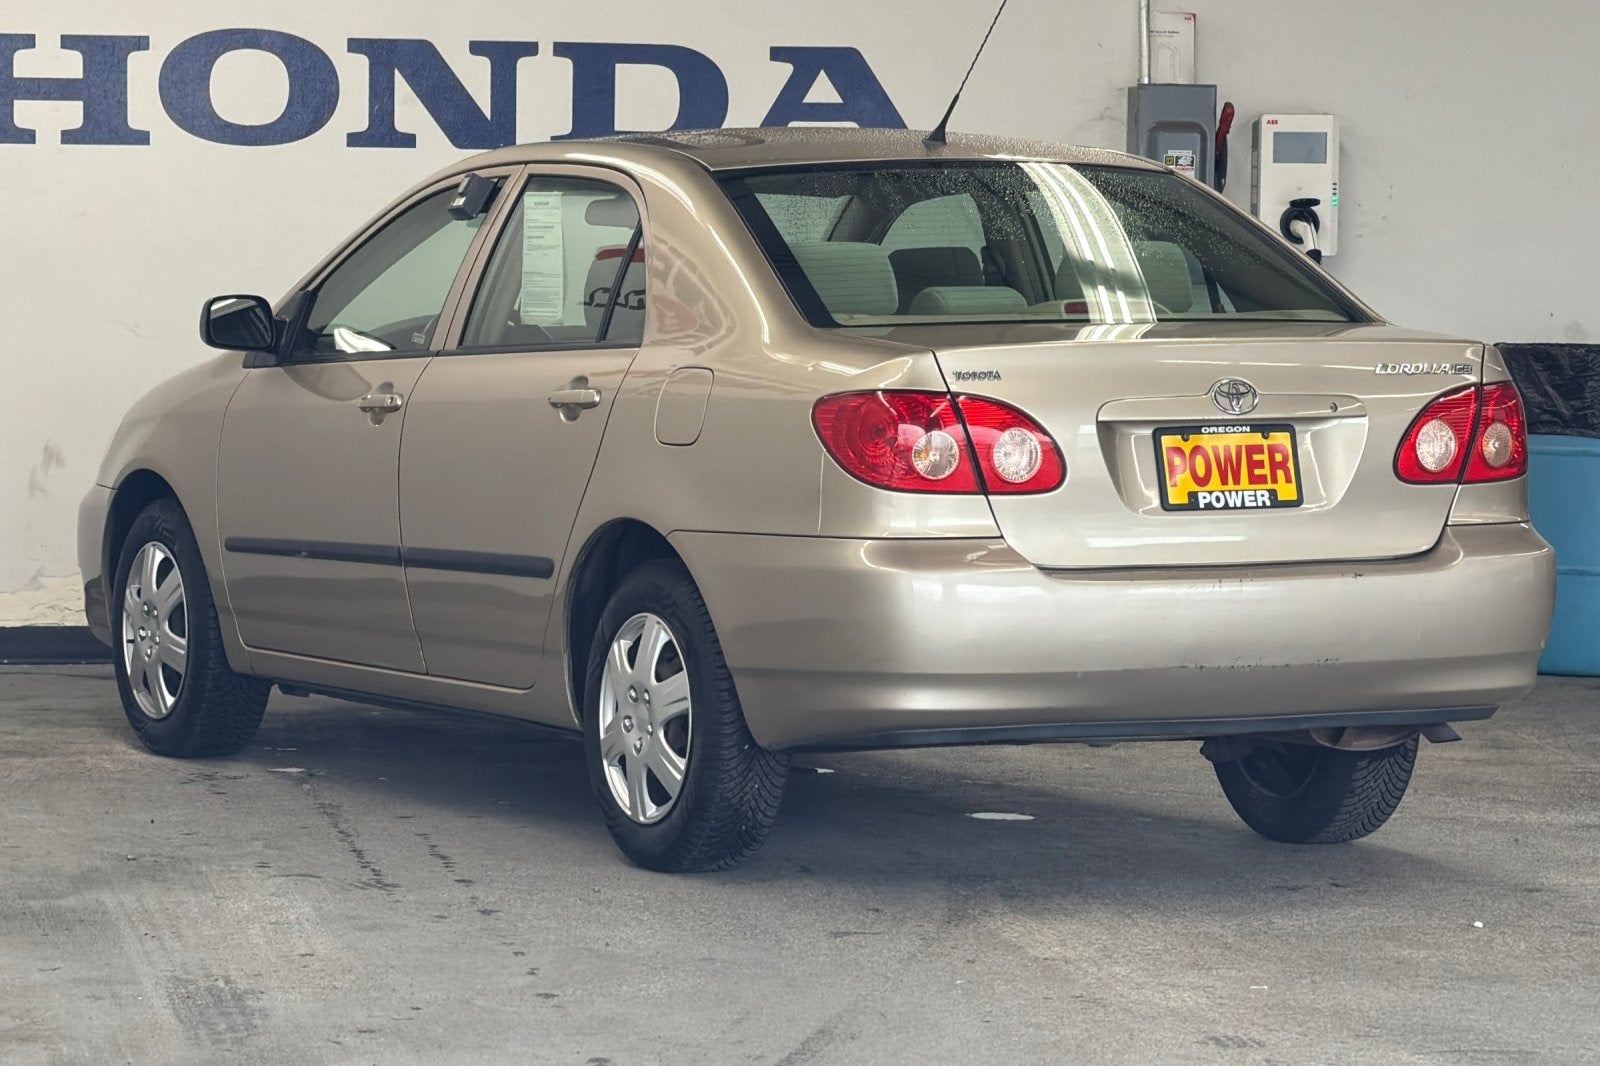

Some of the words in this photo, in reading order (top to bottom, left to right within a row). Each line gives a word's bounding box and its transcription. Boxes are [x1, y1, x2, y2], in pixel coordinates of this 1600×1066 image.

[0, 28, 907, 148] HONDA
[953, 371, 1002, 381] TOYOTA
[1201, 426, 1251, 434] OREGON
[1165, 444, 1293, 487] POWER
[1198, 490, 1271, 509] POWER
